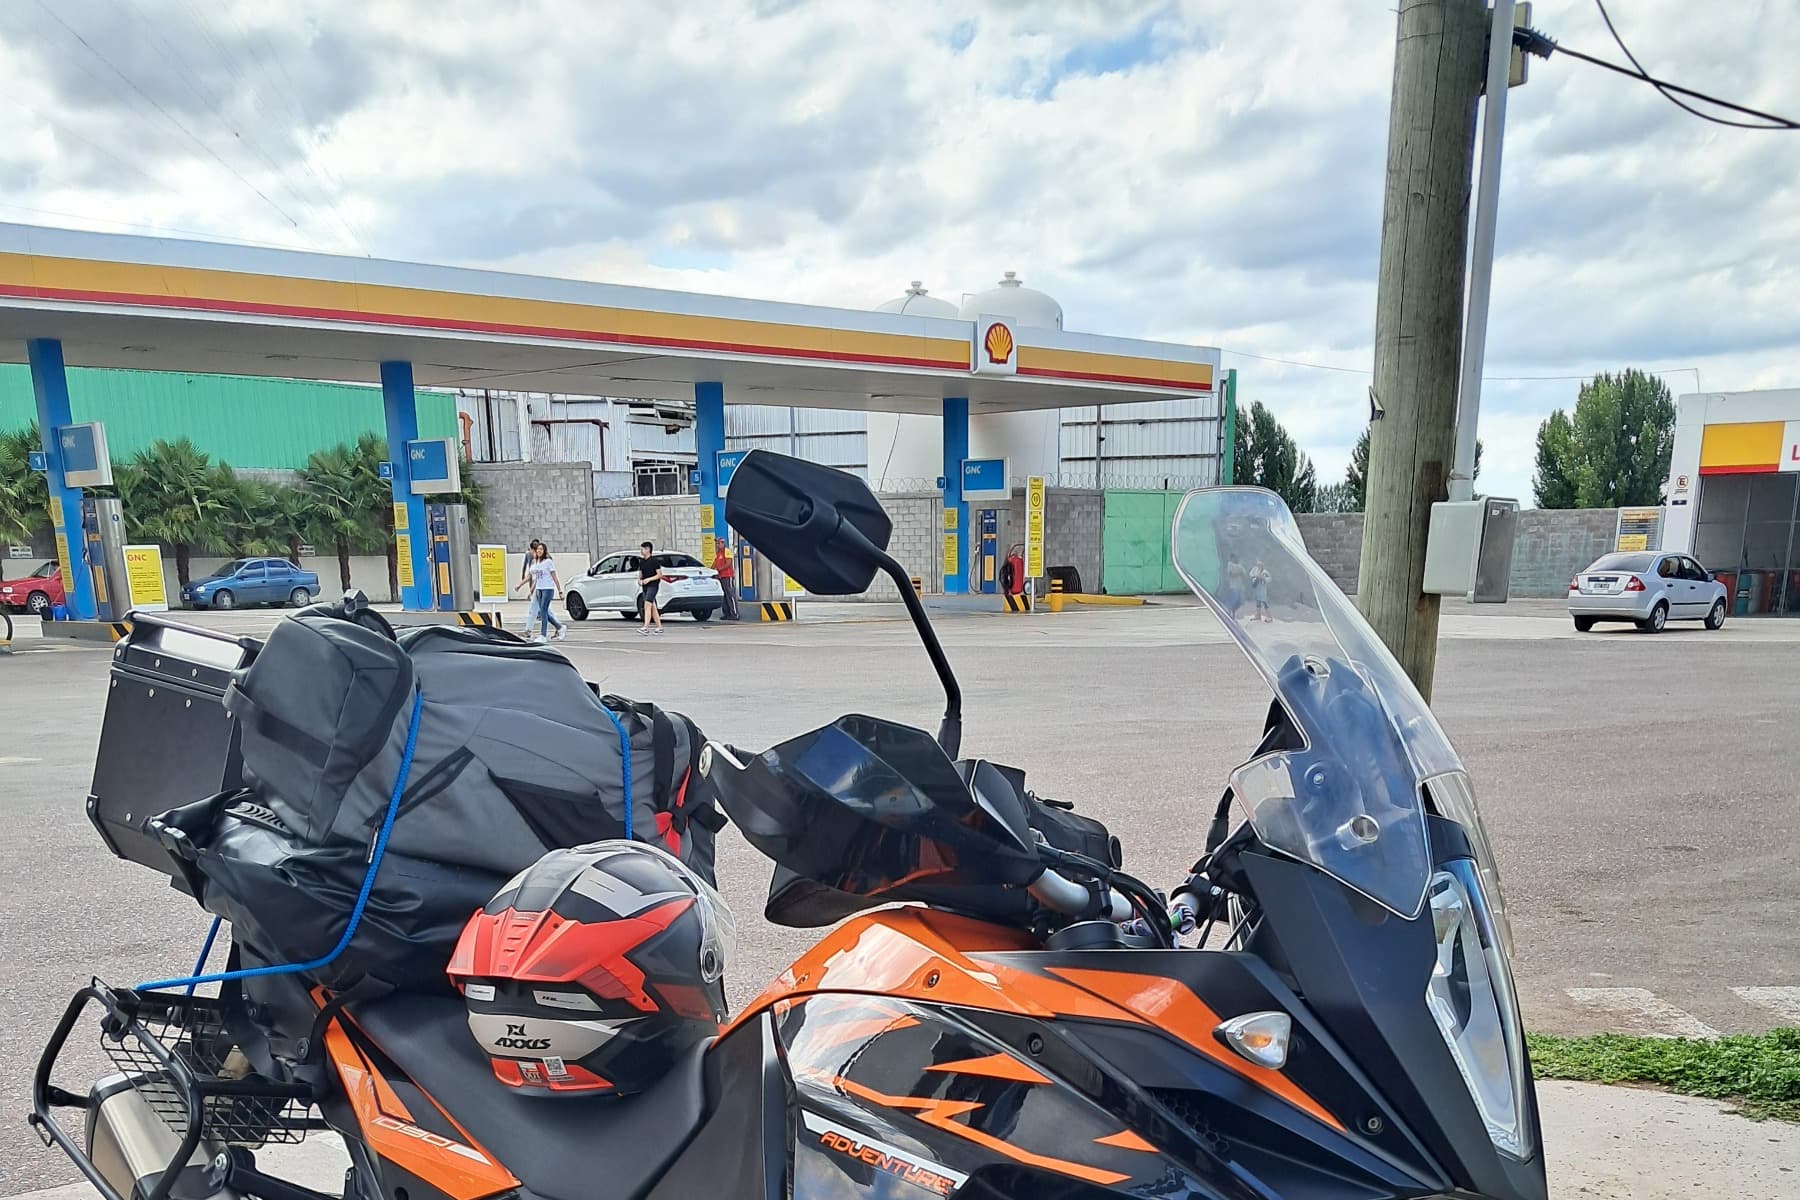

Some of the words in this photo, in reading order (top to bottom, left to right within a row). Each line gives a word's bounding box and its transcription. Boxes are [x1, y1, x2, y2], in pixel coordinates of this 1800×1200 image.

[62, 435, 75, 448] GNC
[410, 449, 425, 459] GNC
[720, 458, 736, 468] GNC
[383, 466, 390, 475] 3
[965, 465, 981, 474] GNC
[127, 553, 147, 562] GNC
[480, 551, 496, 559] GNC
[819, 1130, 957, 1196] ADVENTURE
